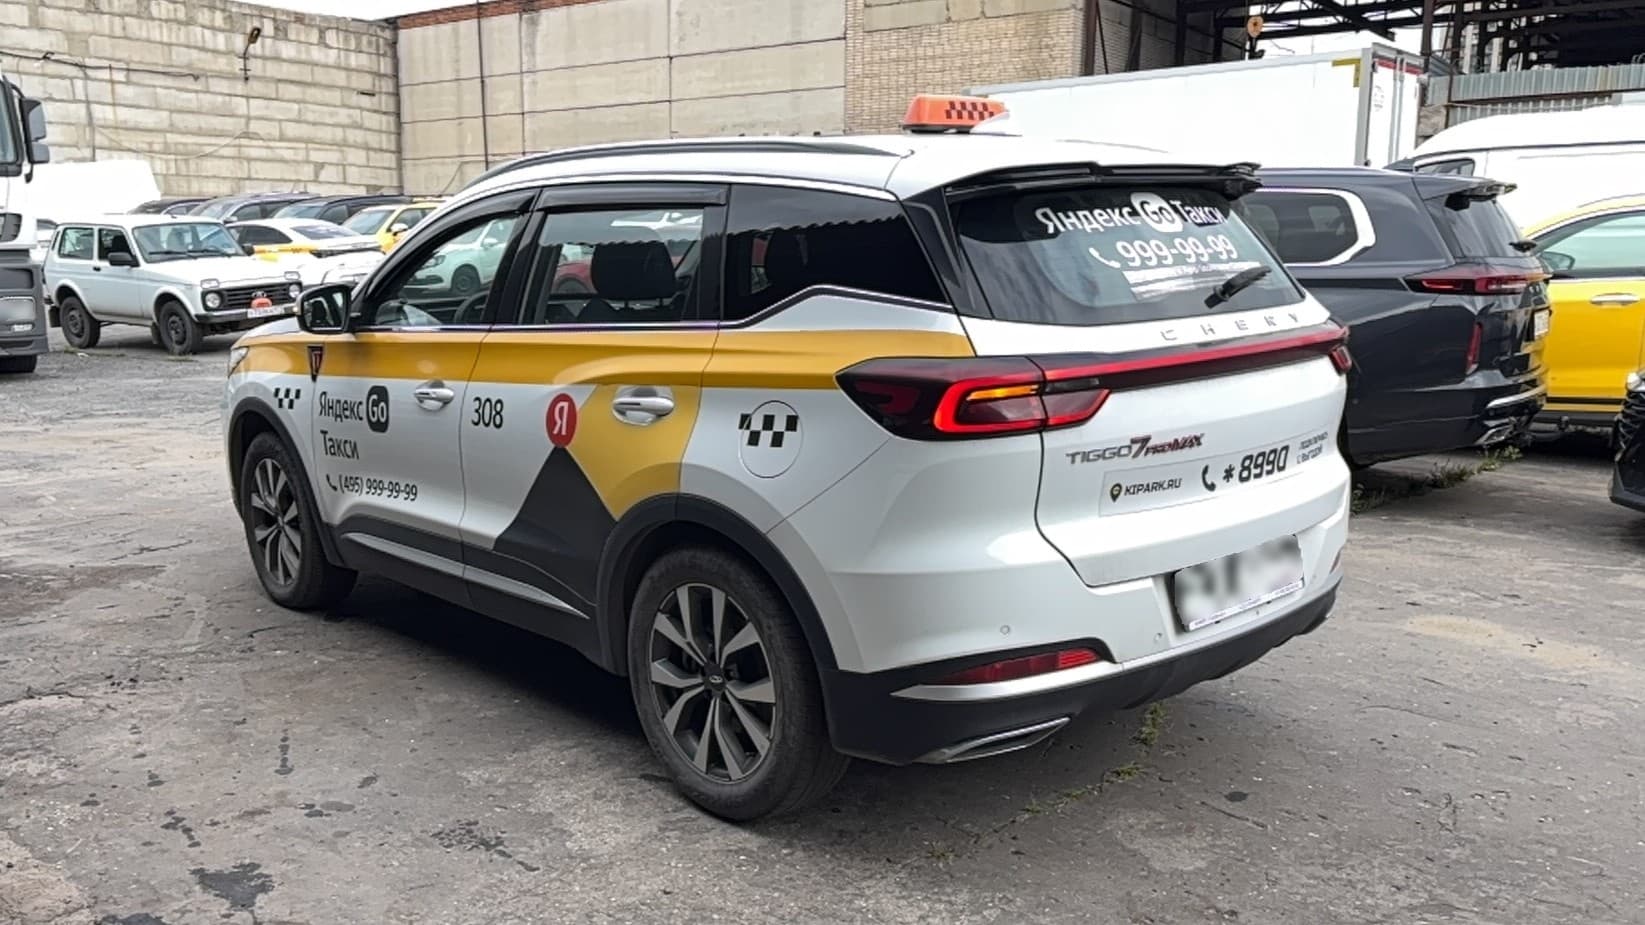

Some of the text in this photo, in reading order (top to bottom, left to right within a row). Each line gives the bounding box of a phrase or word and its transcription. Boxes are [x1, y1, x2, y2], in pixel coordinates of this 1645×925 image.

[1035, 200, 1228, 234] Яндекс Go Такси
[1116, 234, 1239, 267] 999-99-99
[1160, 313, 1299, 341] CHERY
[319, 391, 388, 423] Яндекс Go
[471, 396, 504, 429] 308
[552, 401, 569, 435] Я
[320, 429, 360, 460] Такси
[339, 474, 418, 501] (495) 999-99-99
[1124, 478, 1182, 496] KIPARK.RU
